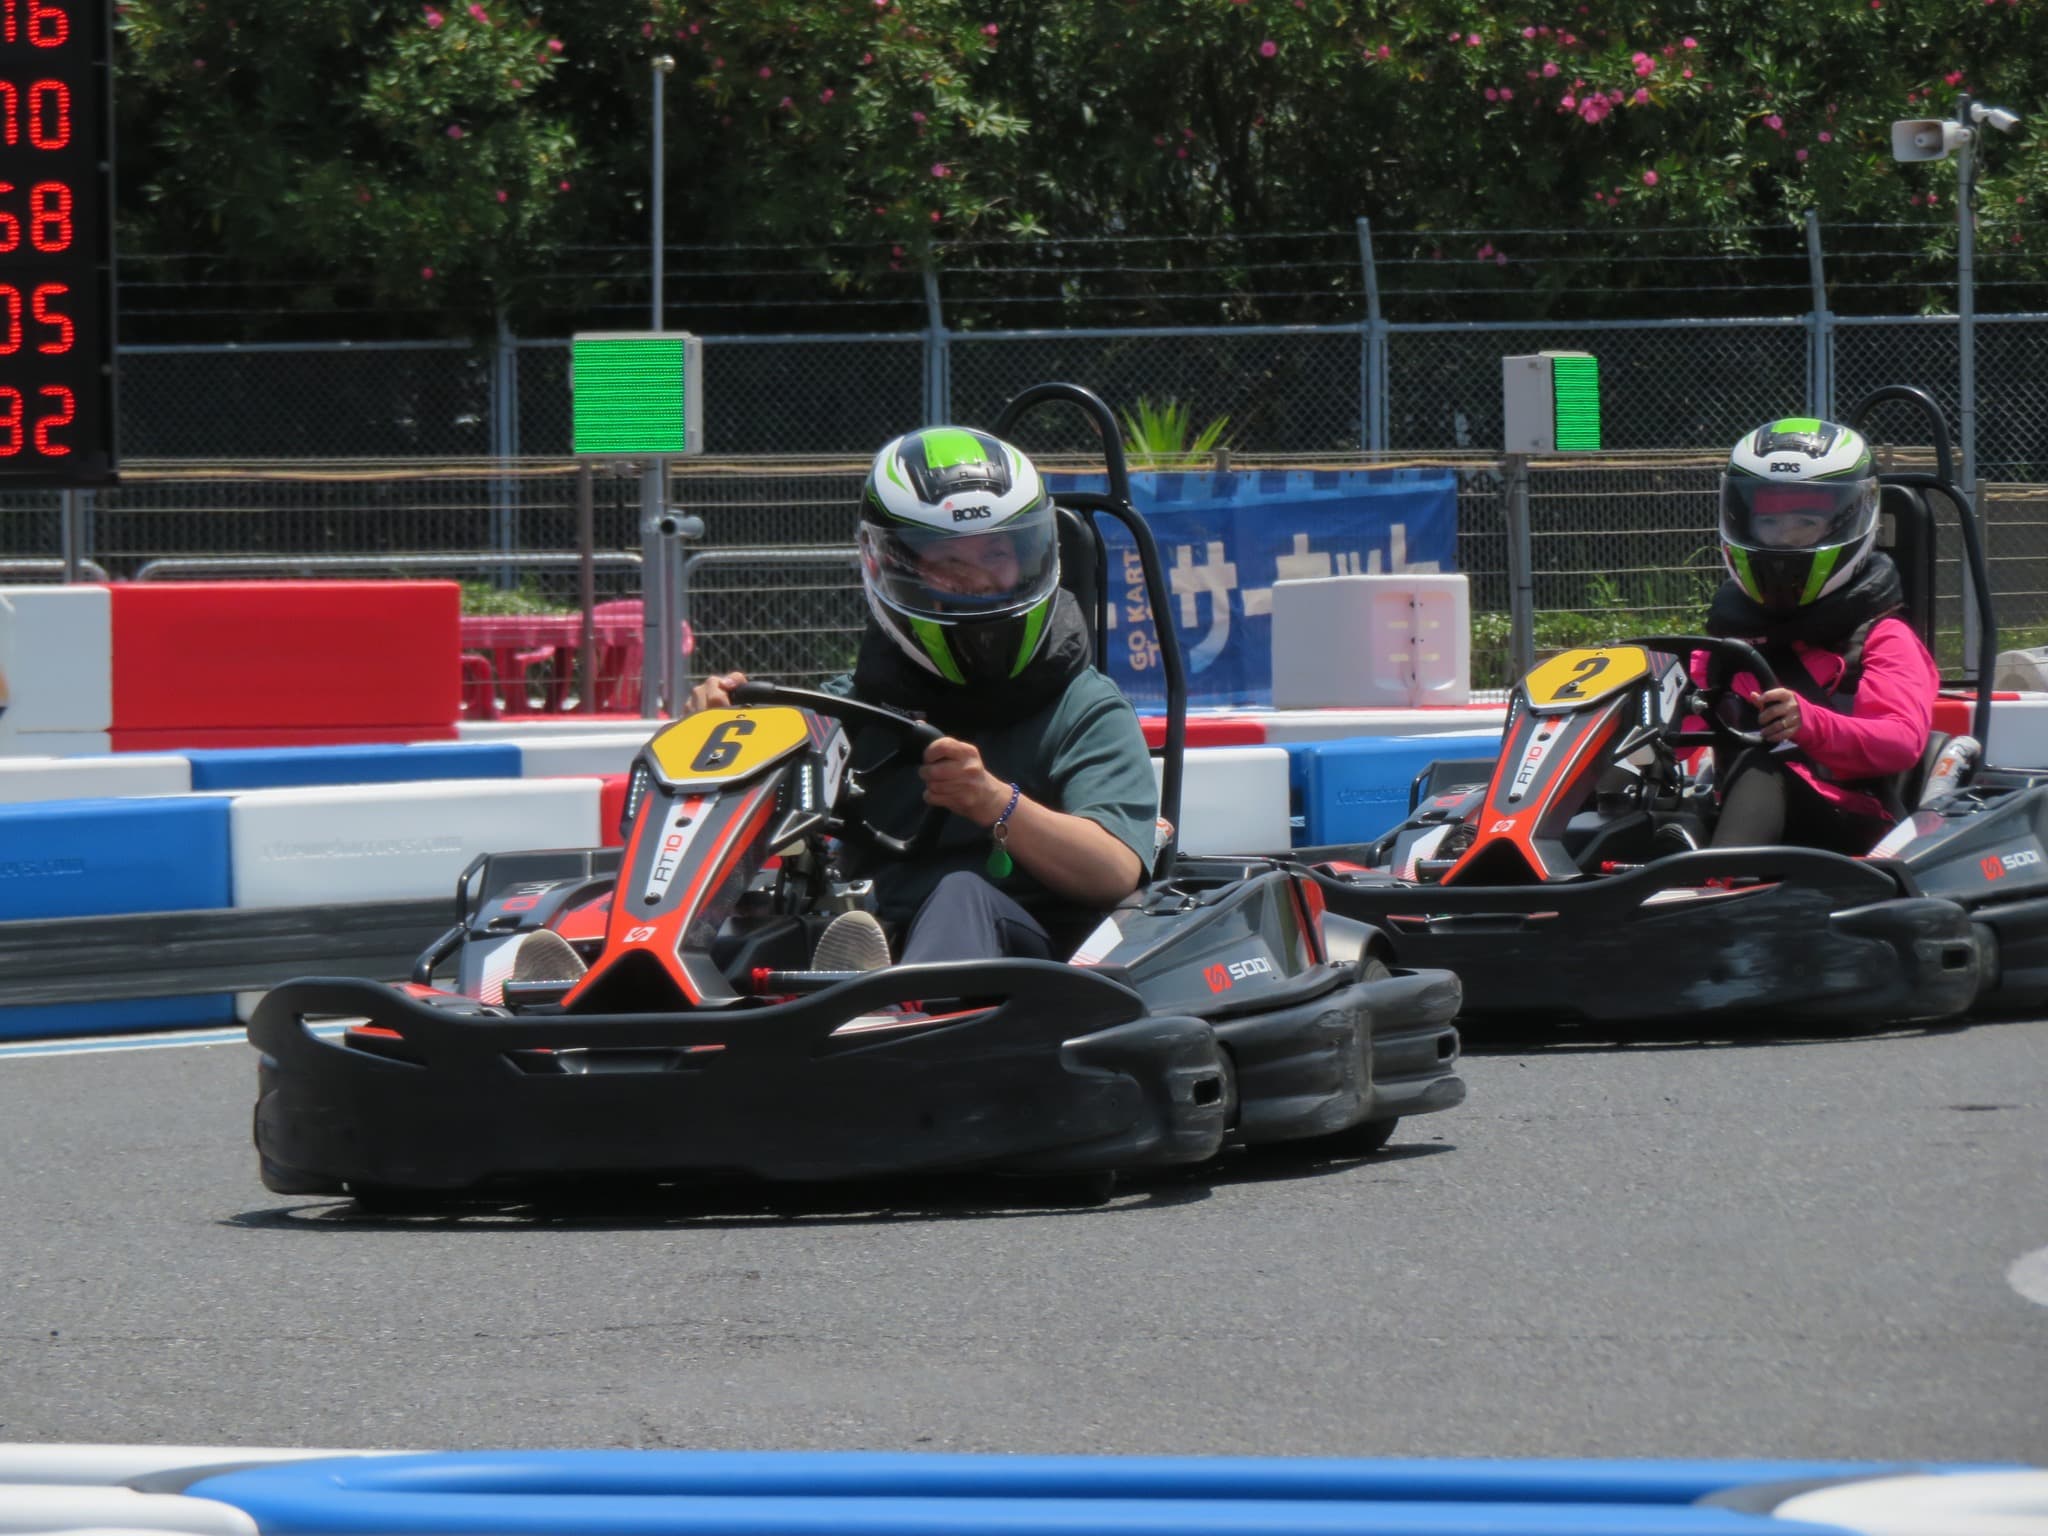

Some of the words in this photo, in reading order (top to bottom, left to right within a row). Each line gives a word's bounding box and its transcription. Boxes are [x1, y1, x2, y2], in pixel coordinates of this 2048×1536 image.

[1769, 462, 1801, 474] BOXS
[952, 505, 992, 523] BOXS
[1123, 550, 1147, 623] KART
[1128, 629, 1149, 671] GO
[1551, 657, 1610, 701] 2
[690, 719, 757, 773] 6
